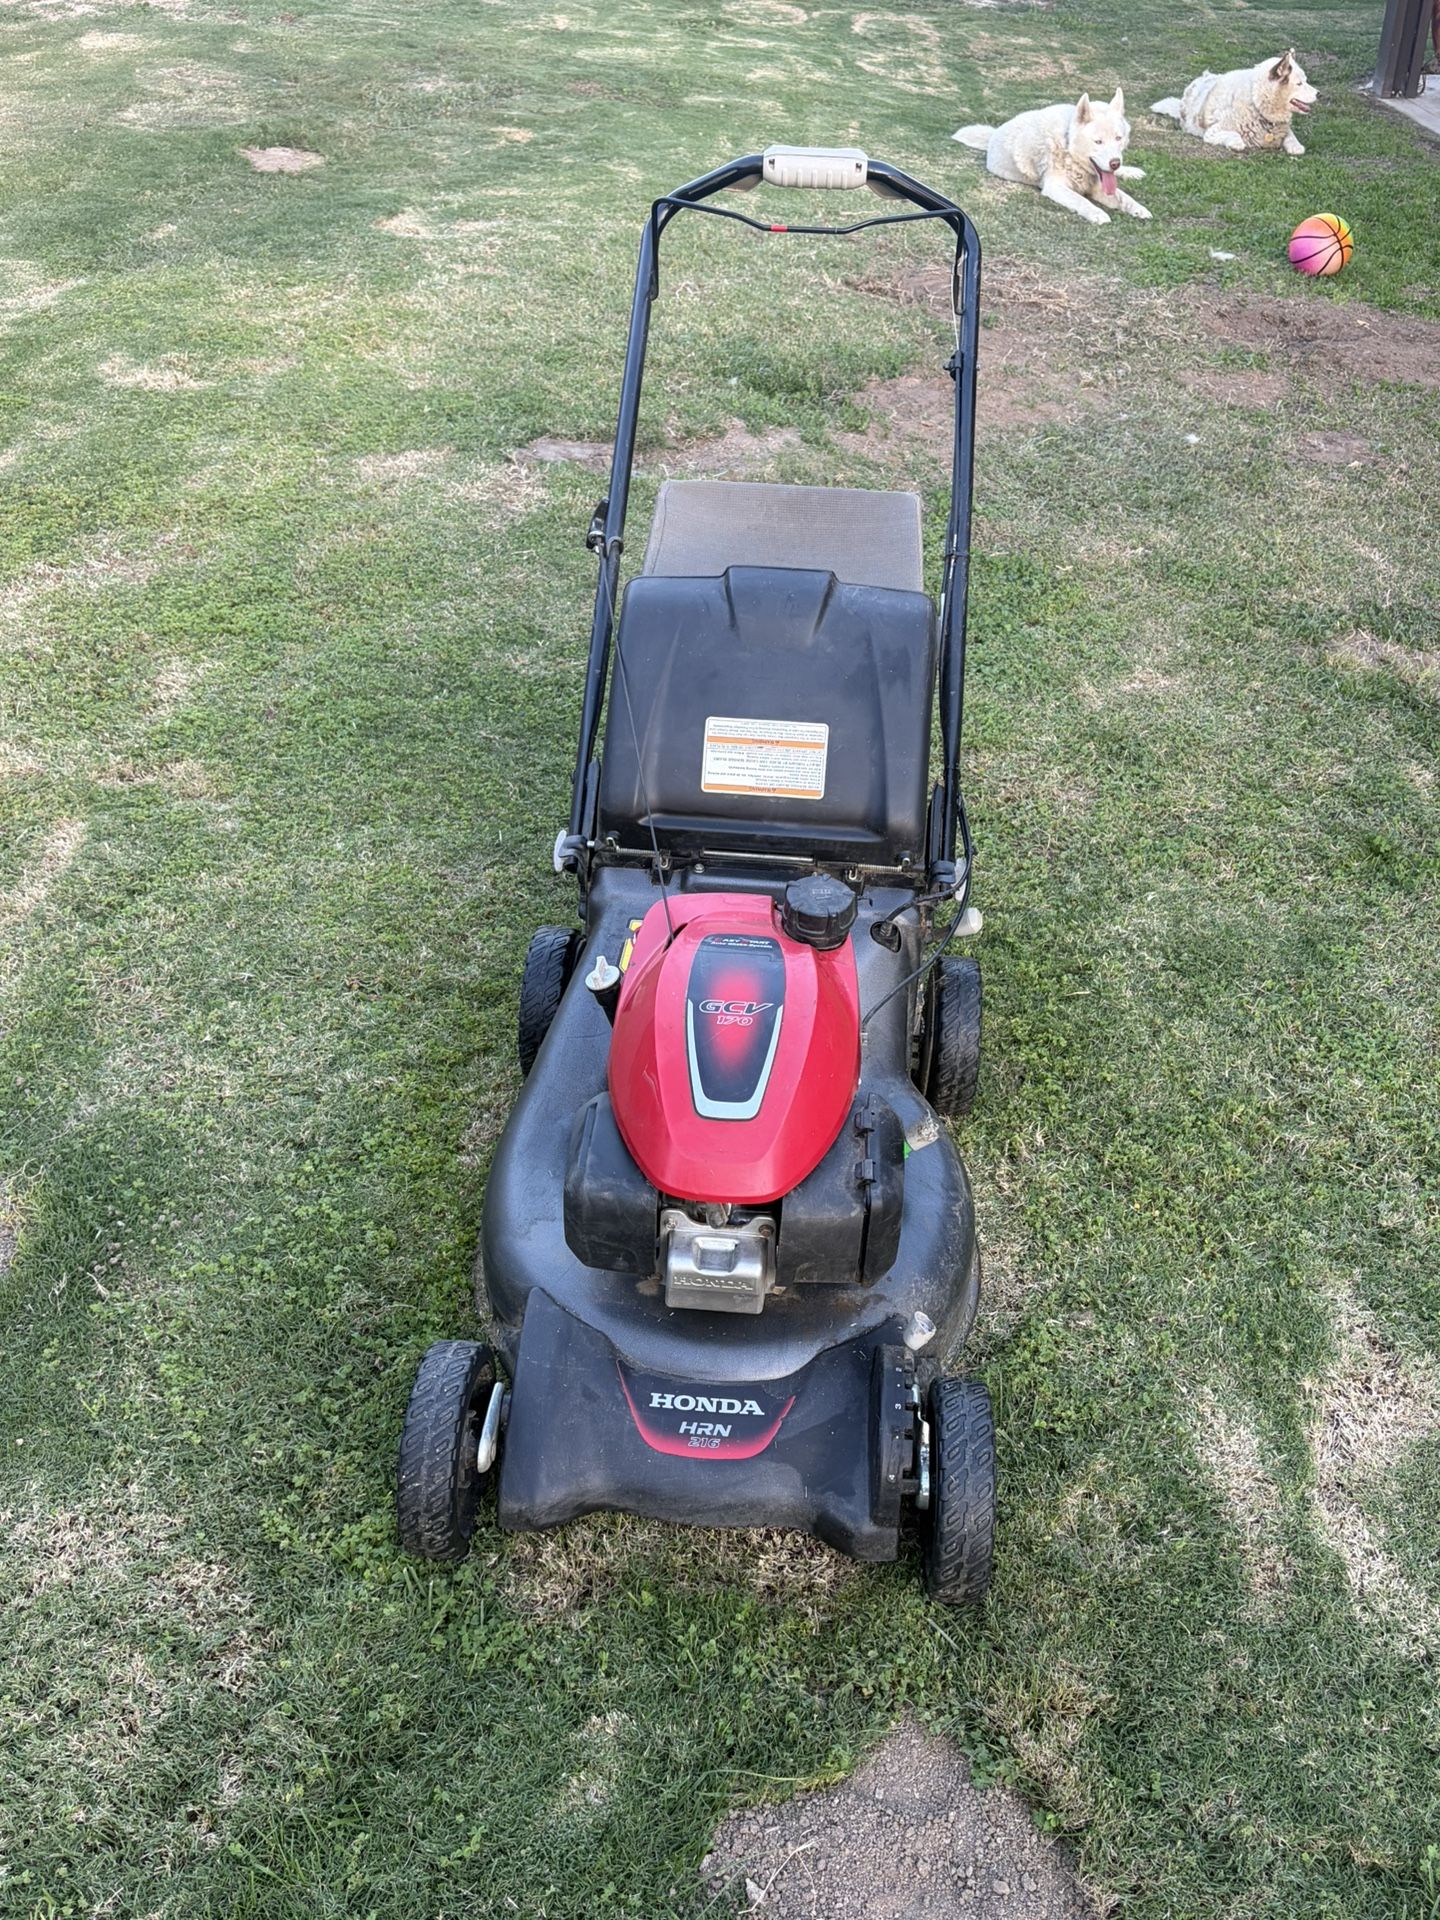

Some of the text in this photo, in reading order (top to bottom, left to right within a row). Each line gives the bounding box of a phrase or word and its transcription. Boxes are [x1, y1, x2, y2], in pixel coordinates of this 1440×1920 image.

[699, 999, 774, 1016] GCV
[716, 1015, 753, 1027] 170
[673, 1276, 753, 1291] HONDA
[649, 1392, 766, 1416] HONDA
[678, 1421, 733, 1437] HRN
[687, 1436, 722, 1449] 216
